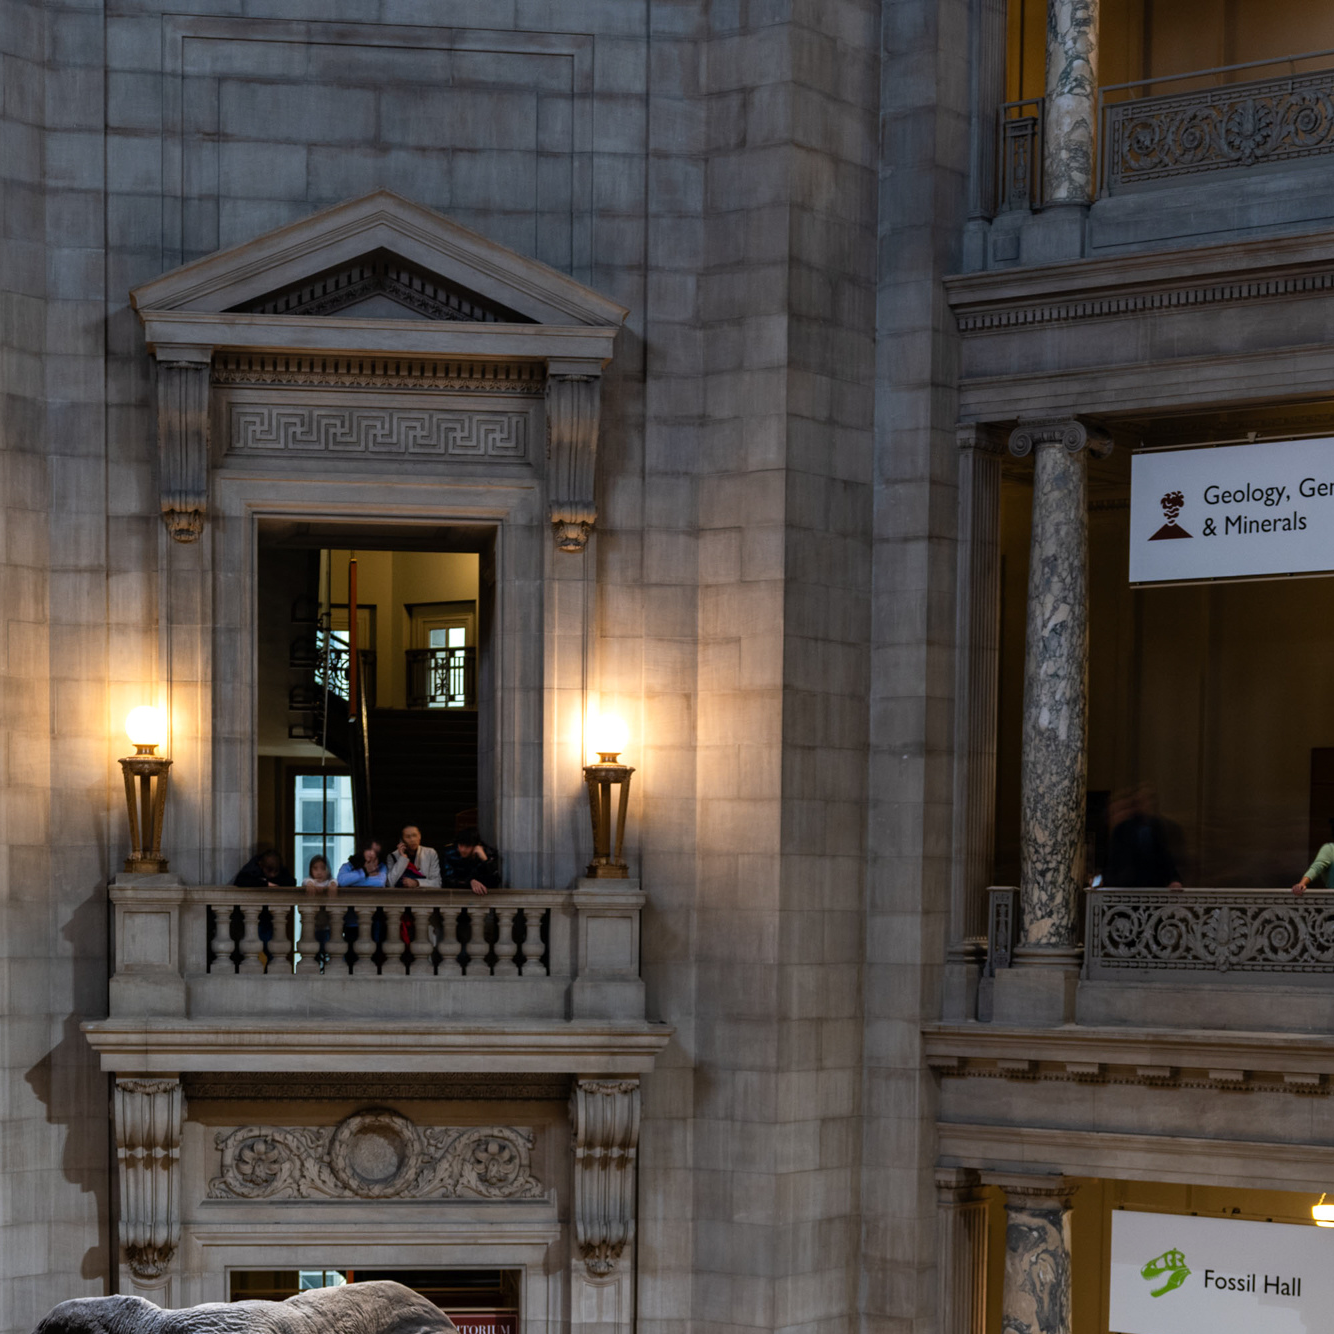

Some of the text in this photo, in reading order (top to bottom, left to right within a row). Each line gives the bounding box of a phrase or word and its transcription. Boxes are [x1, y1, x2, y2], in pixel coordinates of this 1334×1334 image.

[1204, 483, 1290, 506] Geology,
[1202, 511, 1307, 536] & Minerals
[1204, 1269, 1301, 1297] Fossil Hall
